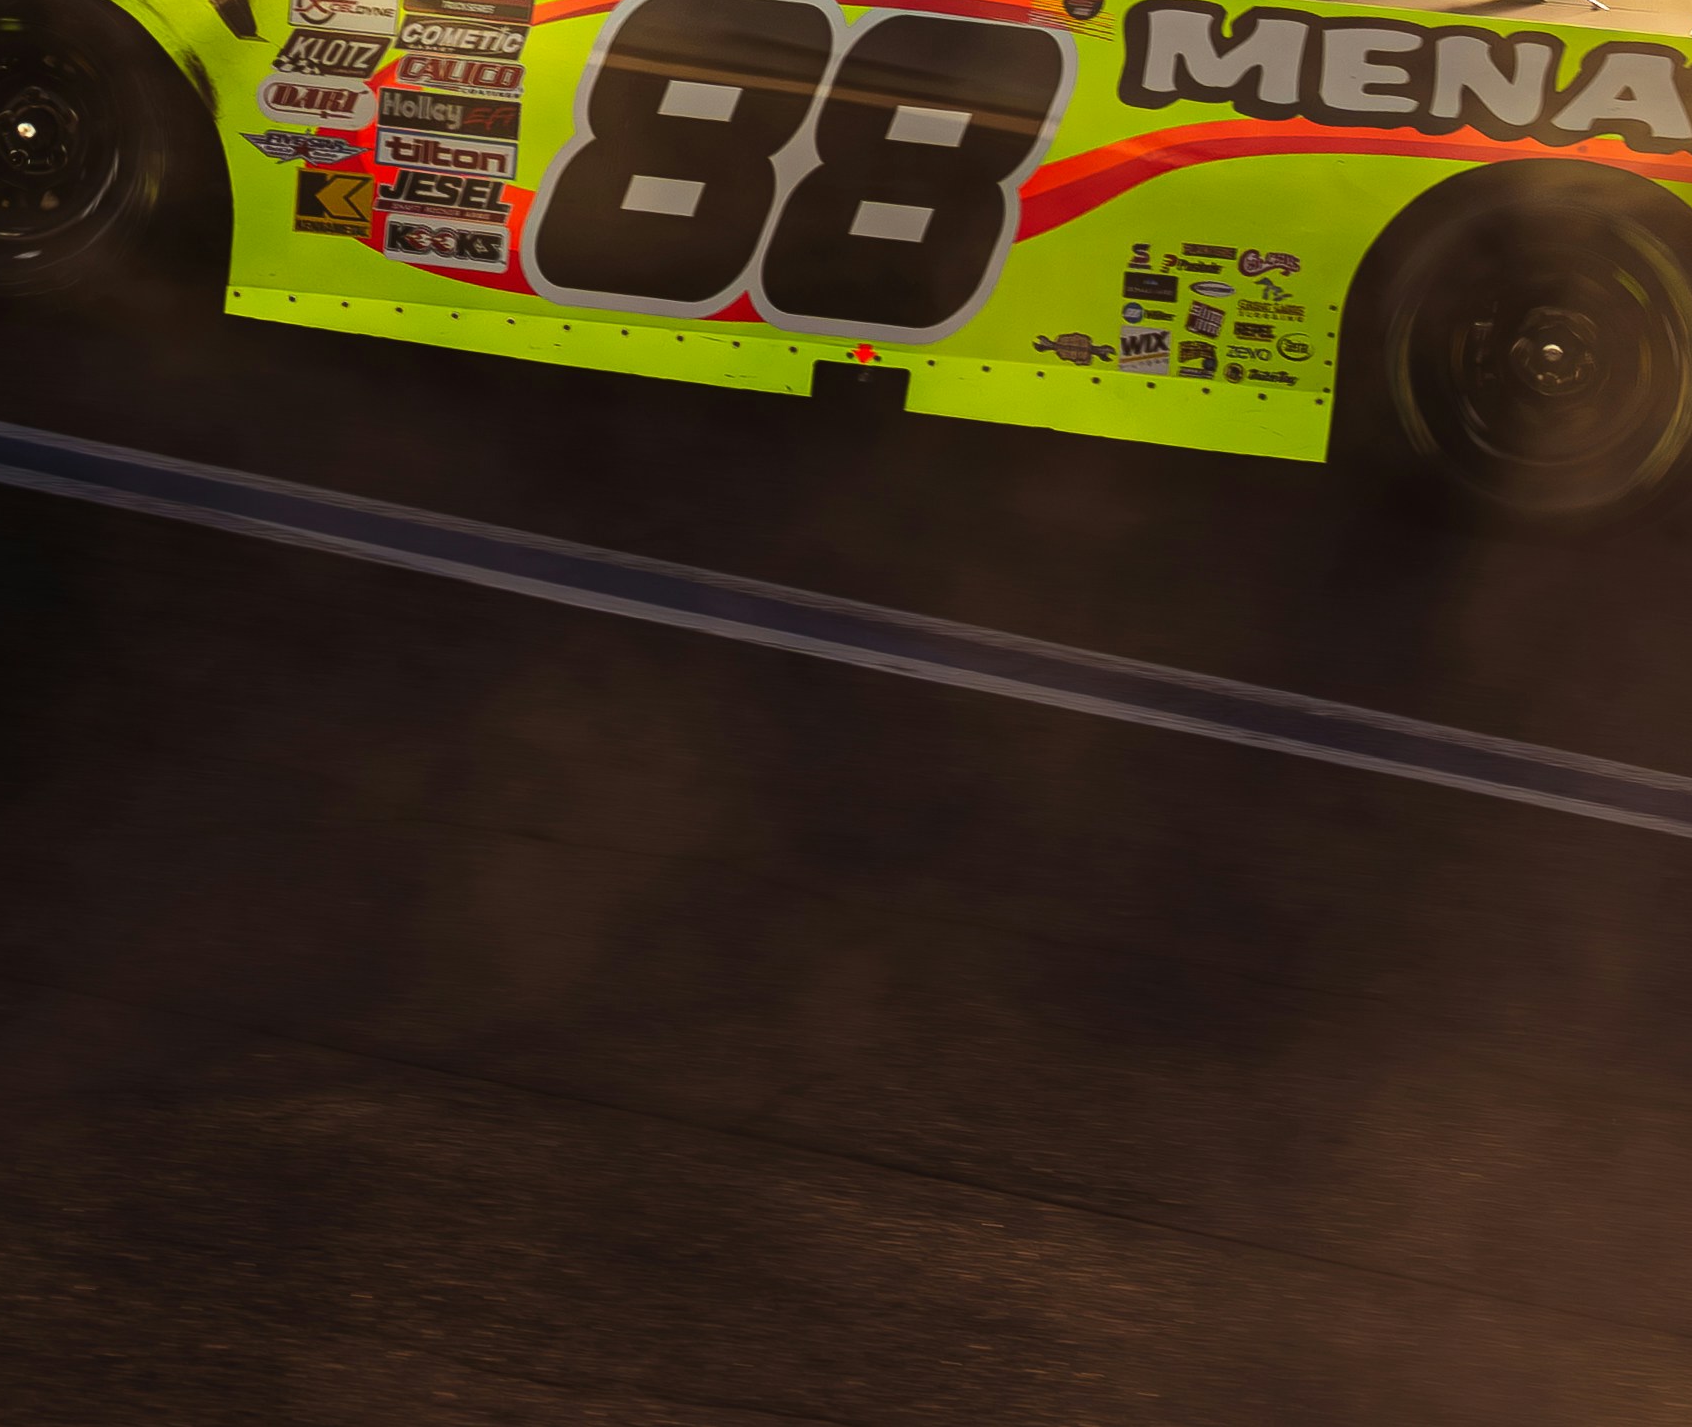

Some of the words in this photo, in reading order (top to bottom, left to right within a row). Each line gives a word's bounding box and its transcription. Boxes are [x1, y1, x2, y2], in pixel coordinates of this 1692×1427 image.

[288, 36, 382, 69] KLOTZ
[401, 22, 525, 54] COMETIC
[399, 54, 524, 90] CALICO
[382, 91, 463, 131] Holley
[384, 135, 507, 174] tilton
[378, 169, 513, 214] JESEL
[1119, 330, 1171, 357] WIX
